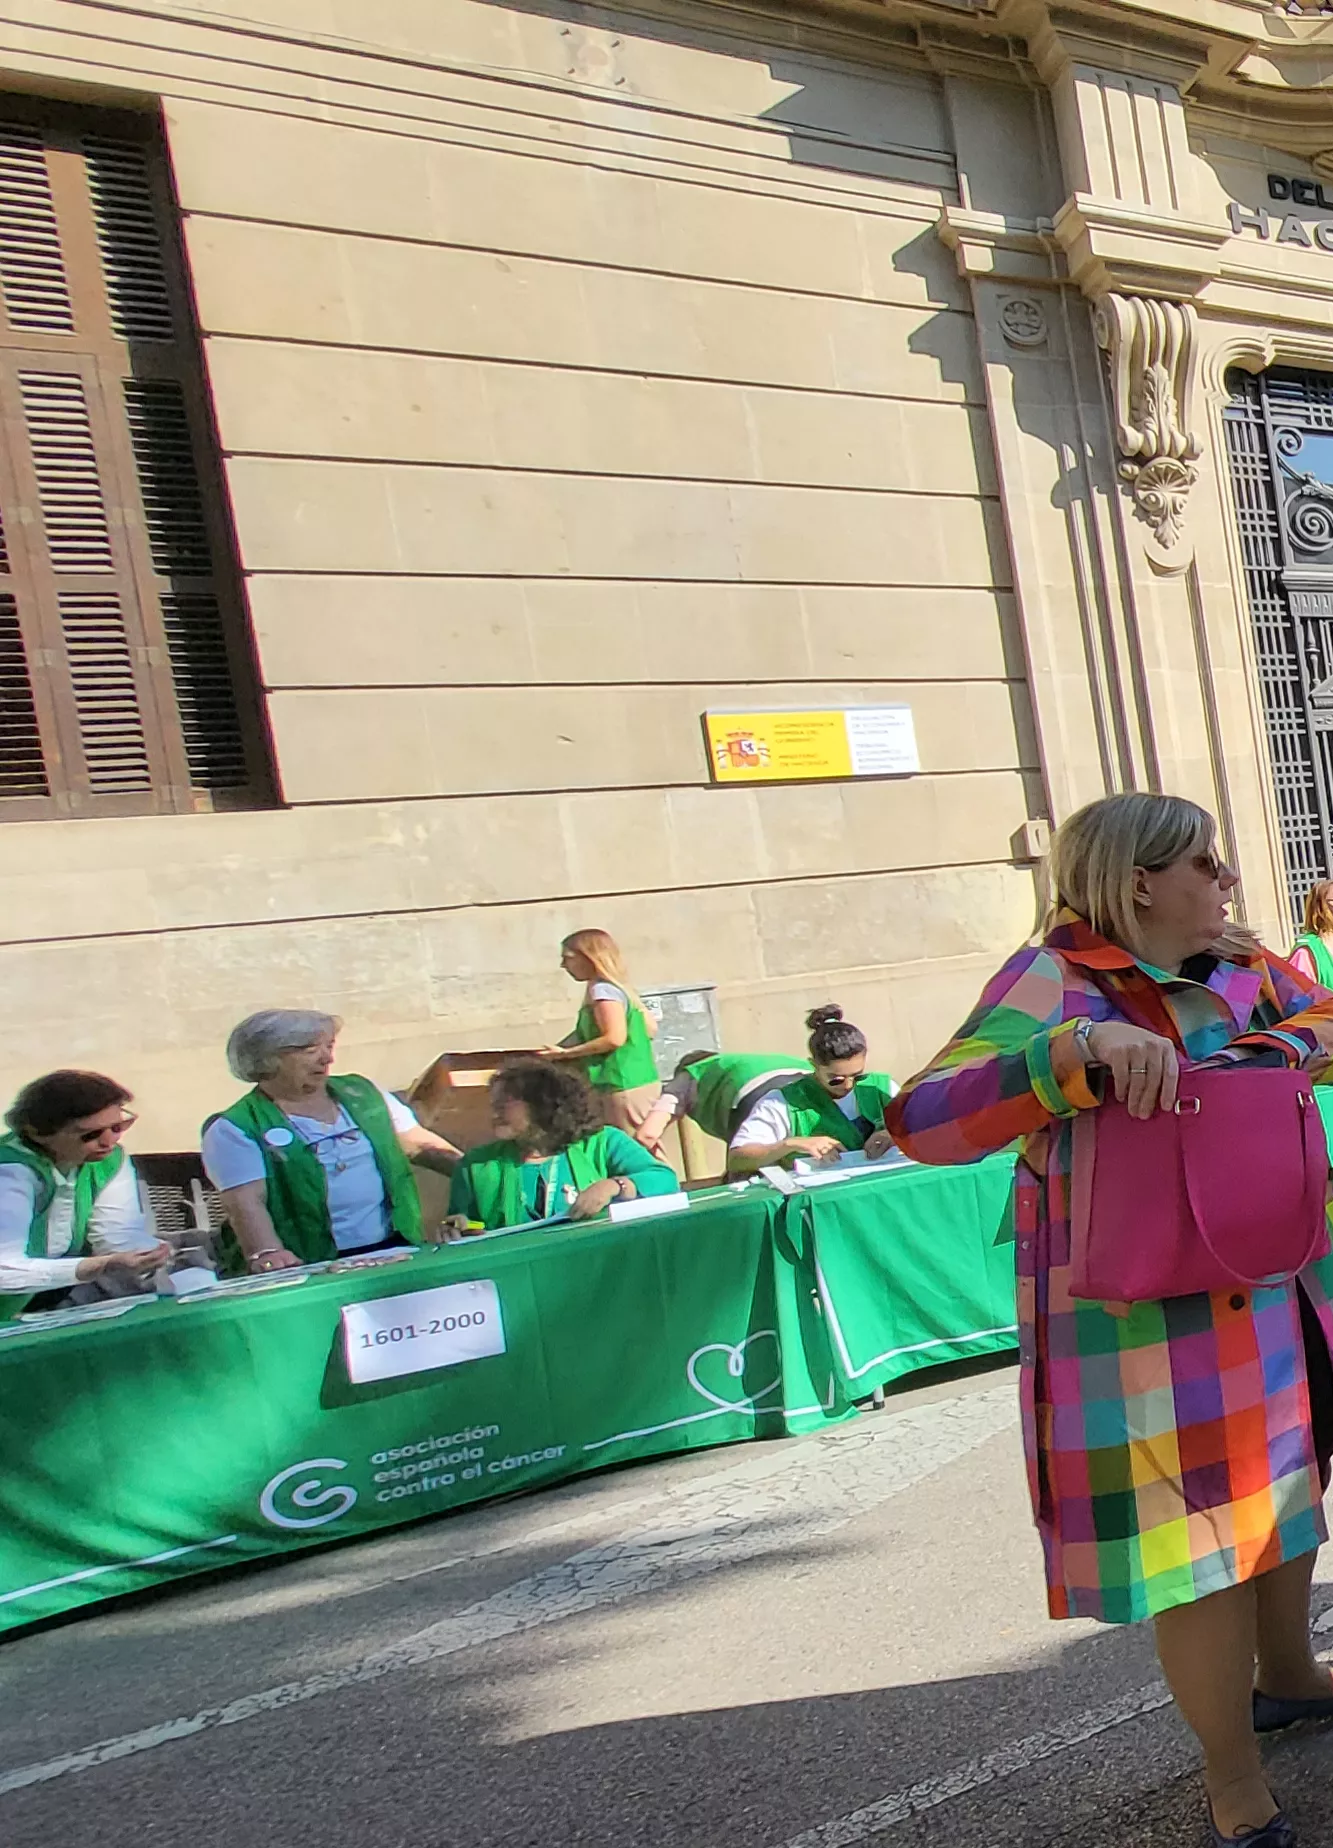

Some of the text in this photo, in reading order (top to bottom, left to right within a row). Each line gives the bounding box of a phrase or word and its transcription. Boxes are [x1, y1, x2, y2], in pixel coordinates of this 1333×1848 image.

[360, 1311, 486, 1349] 1601-2000
[371, 1424, 500, 1464] asociación
[373, 1446, 484, 1483] española
[376, 1444, 567, 1502] contra el cáncer
